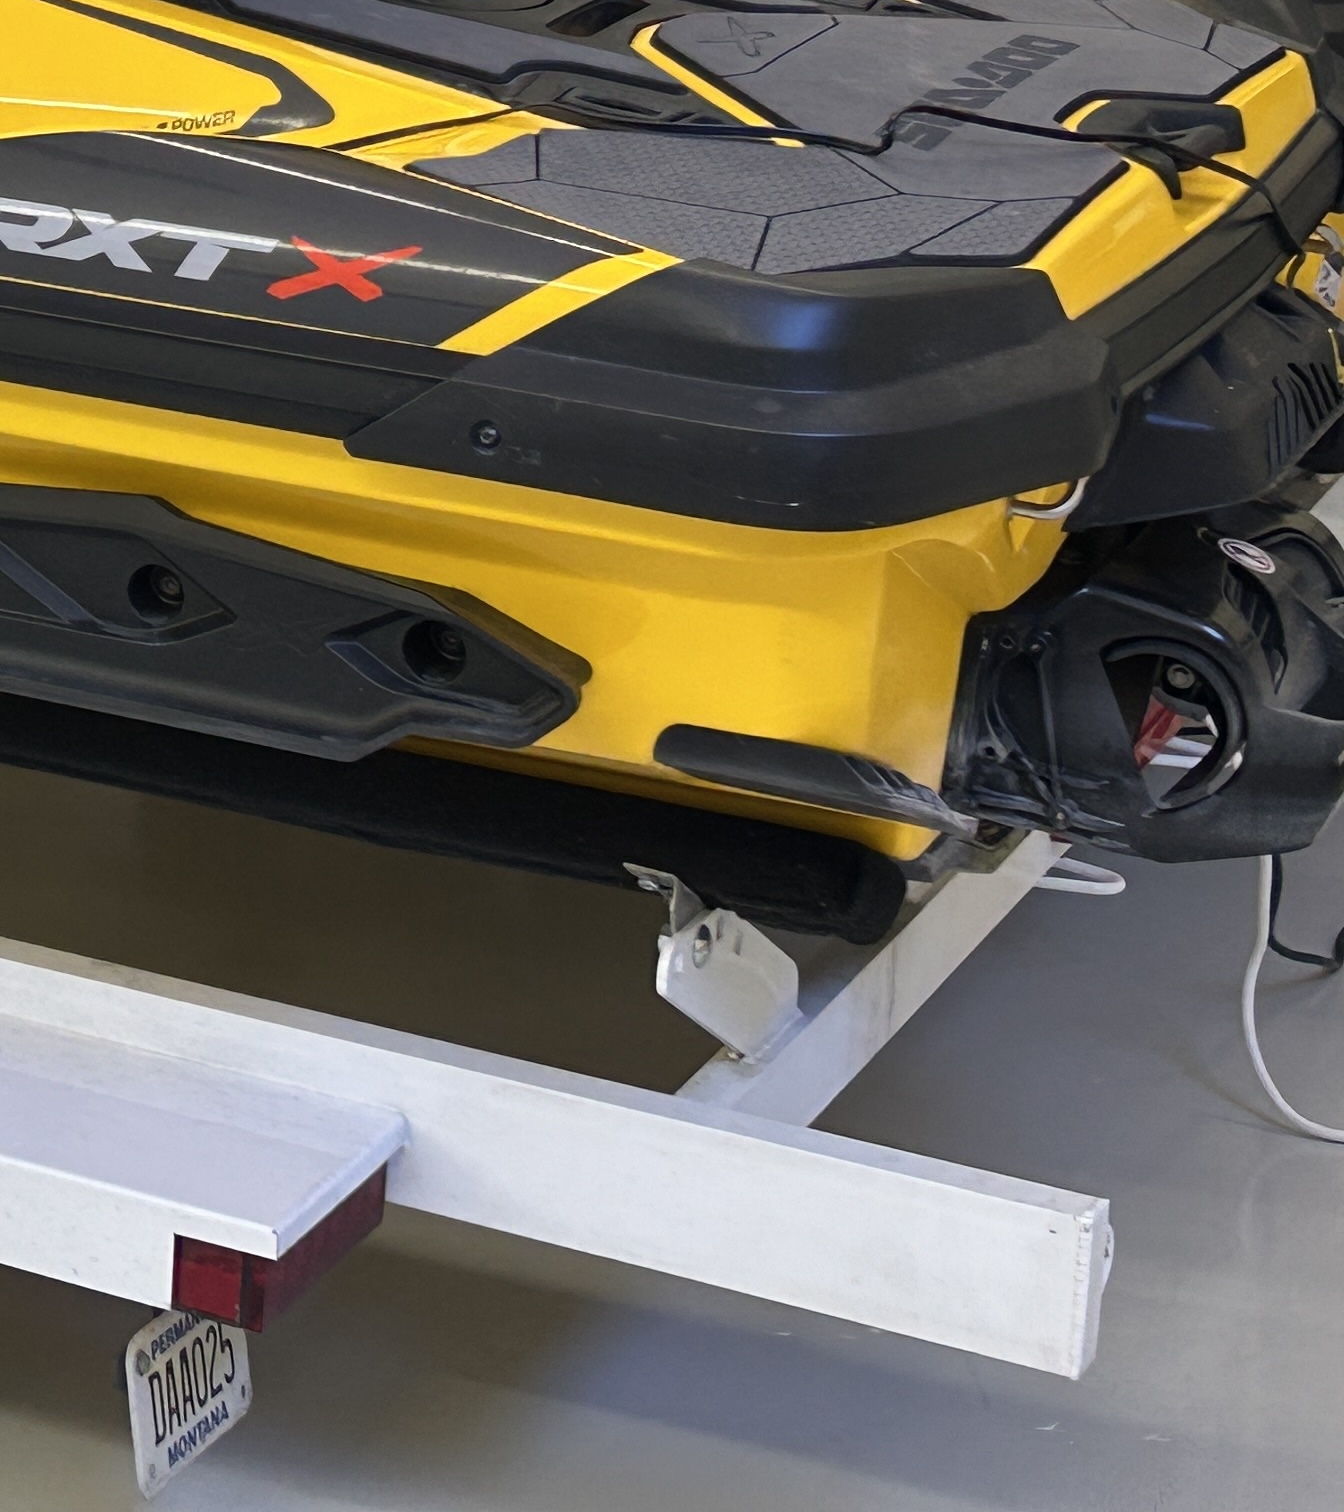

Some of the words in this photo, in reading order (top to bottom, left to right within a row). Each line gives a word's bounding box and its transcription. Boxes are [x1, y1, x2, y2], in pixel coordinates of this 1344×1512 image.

[171, 109, 236, 132] POWER
[266, 235, 423, 302] X
[148, 1320, 236, 1447] DAA025
[168, 1400, 230, 1469] MONTANA
